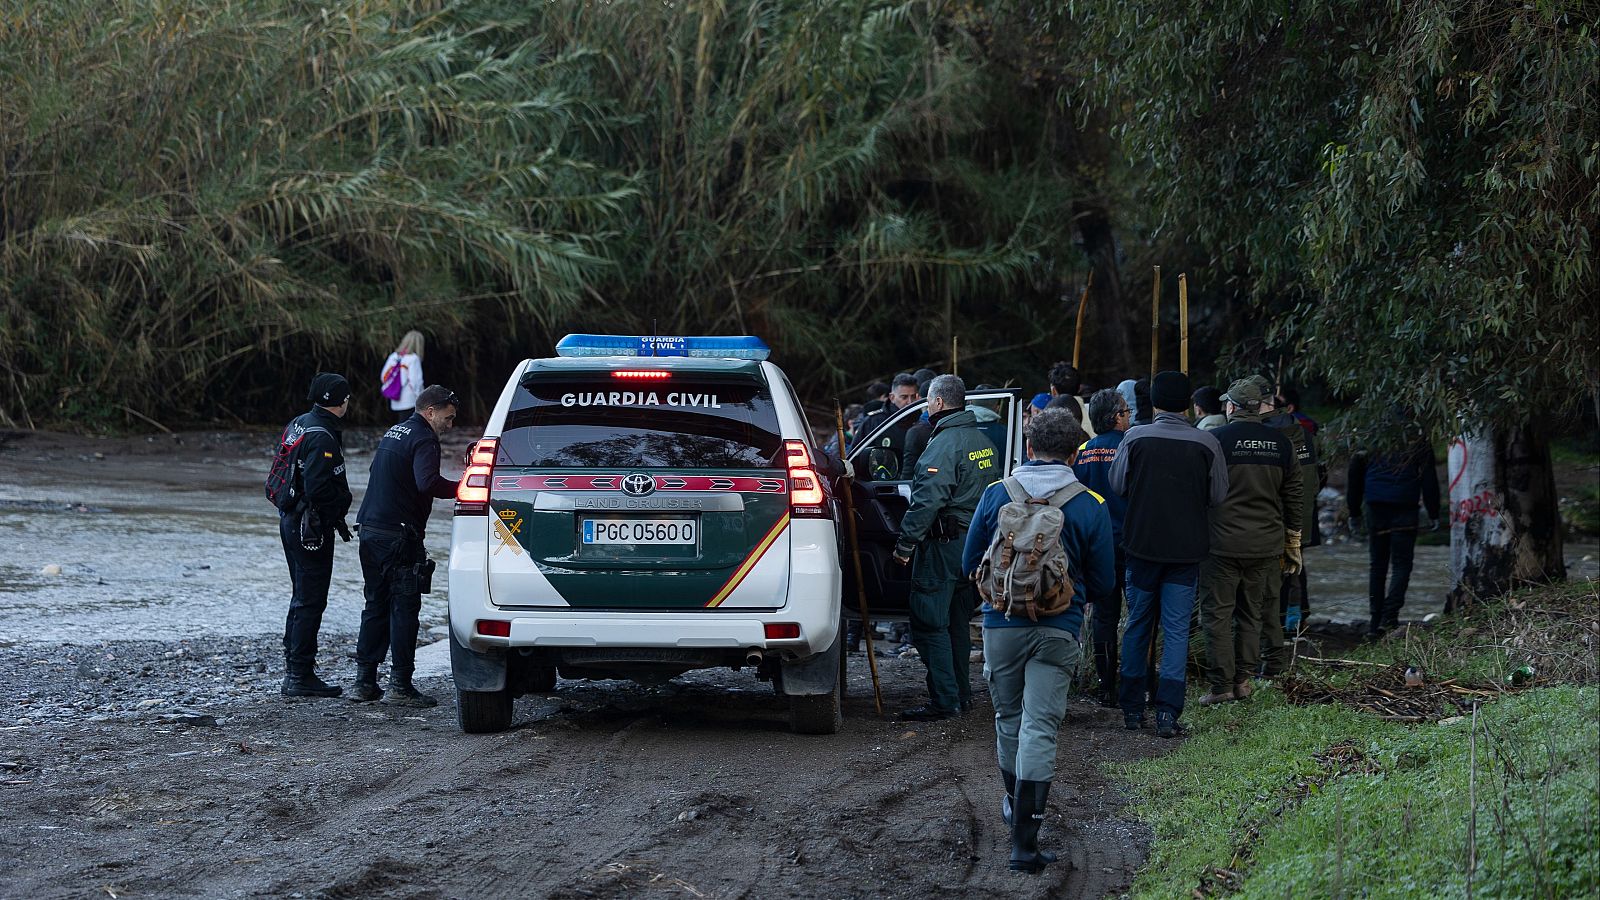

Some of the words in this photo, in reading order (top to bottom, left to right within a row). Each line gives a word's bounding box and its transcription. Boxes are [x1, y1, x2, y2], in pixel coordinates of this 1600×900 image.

[560, 391, 660, 407] GUARDIA
[666, 392, 721, 409] CIVIL
[1234, 439, 1278, 451] AGENTE
[968, 447, 994, 461] GUARDIA
[1231, 450, 1253, 458] MEDIO
[1253, 450, 1281, 459] AMBIENTE
[978, 458, 993, 470] CIVIL
[574, 497, 619, 509] LAND
[626, 497, 703, 509] CRUISER
[596, 523, 629, 541] PGC
[633, 523, 678, 541] 0560
